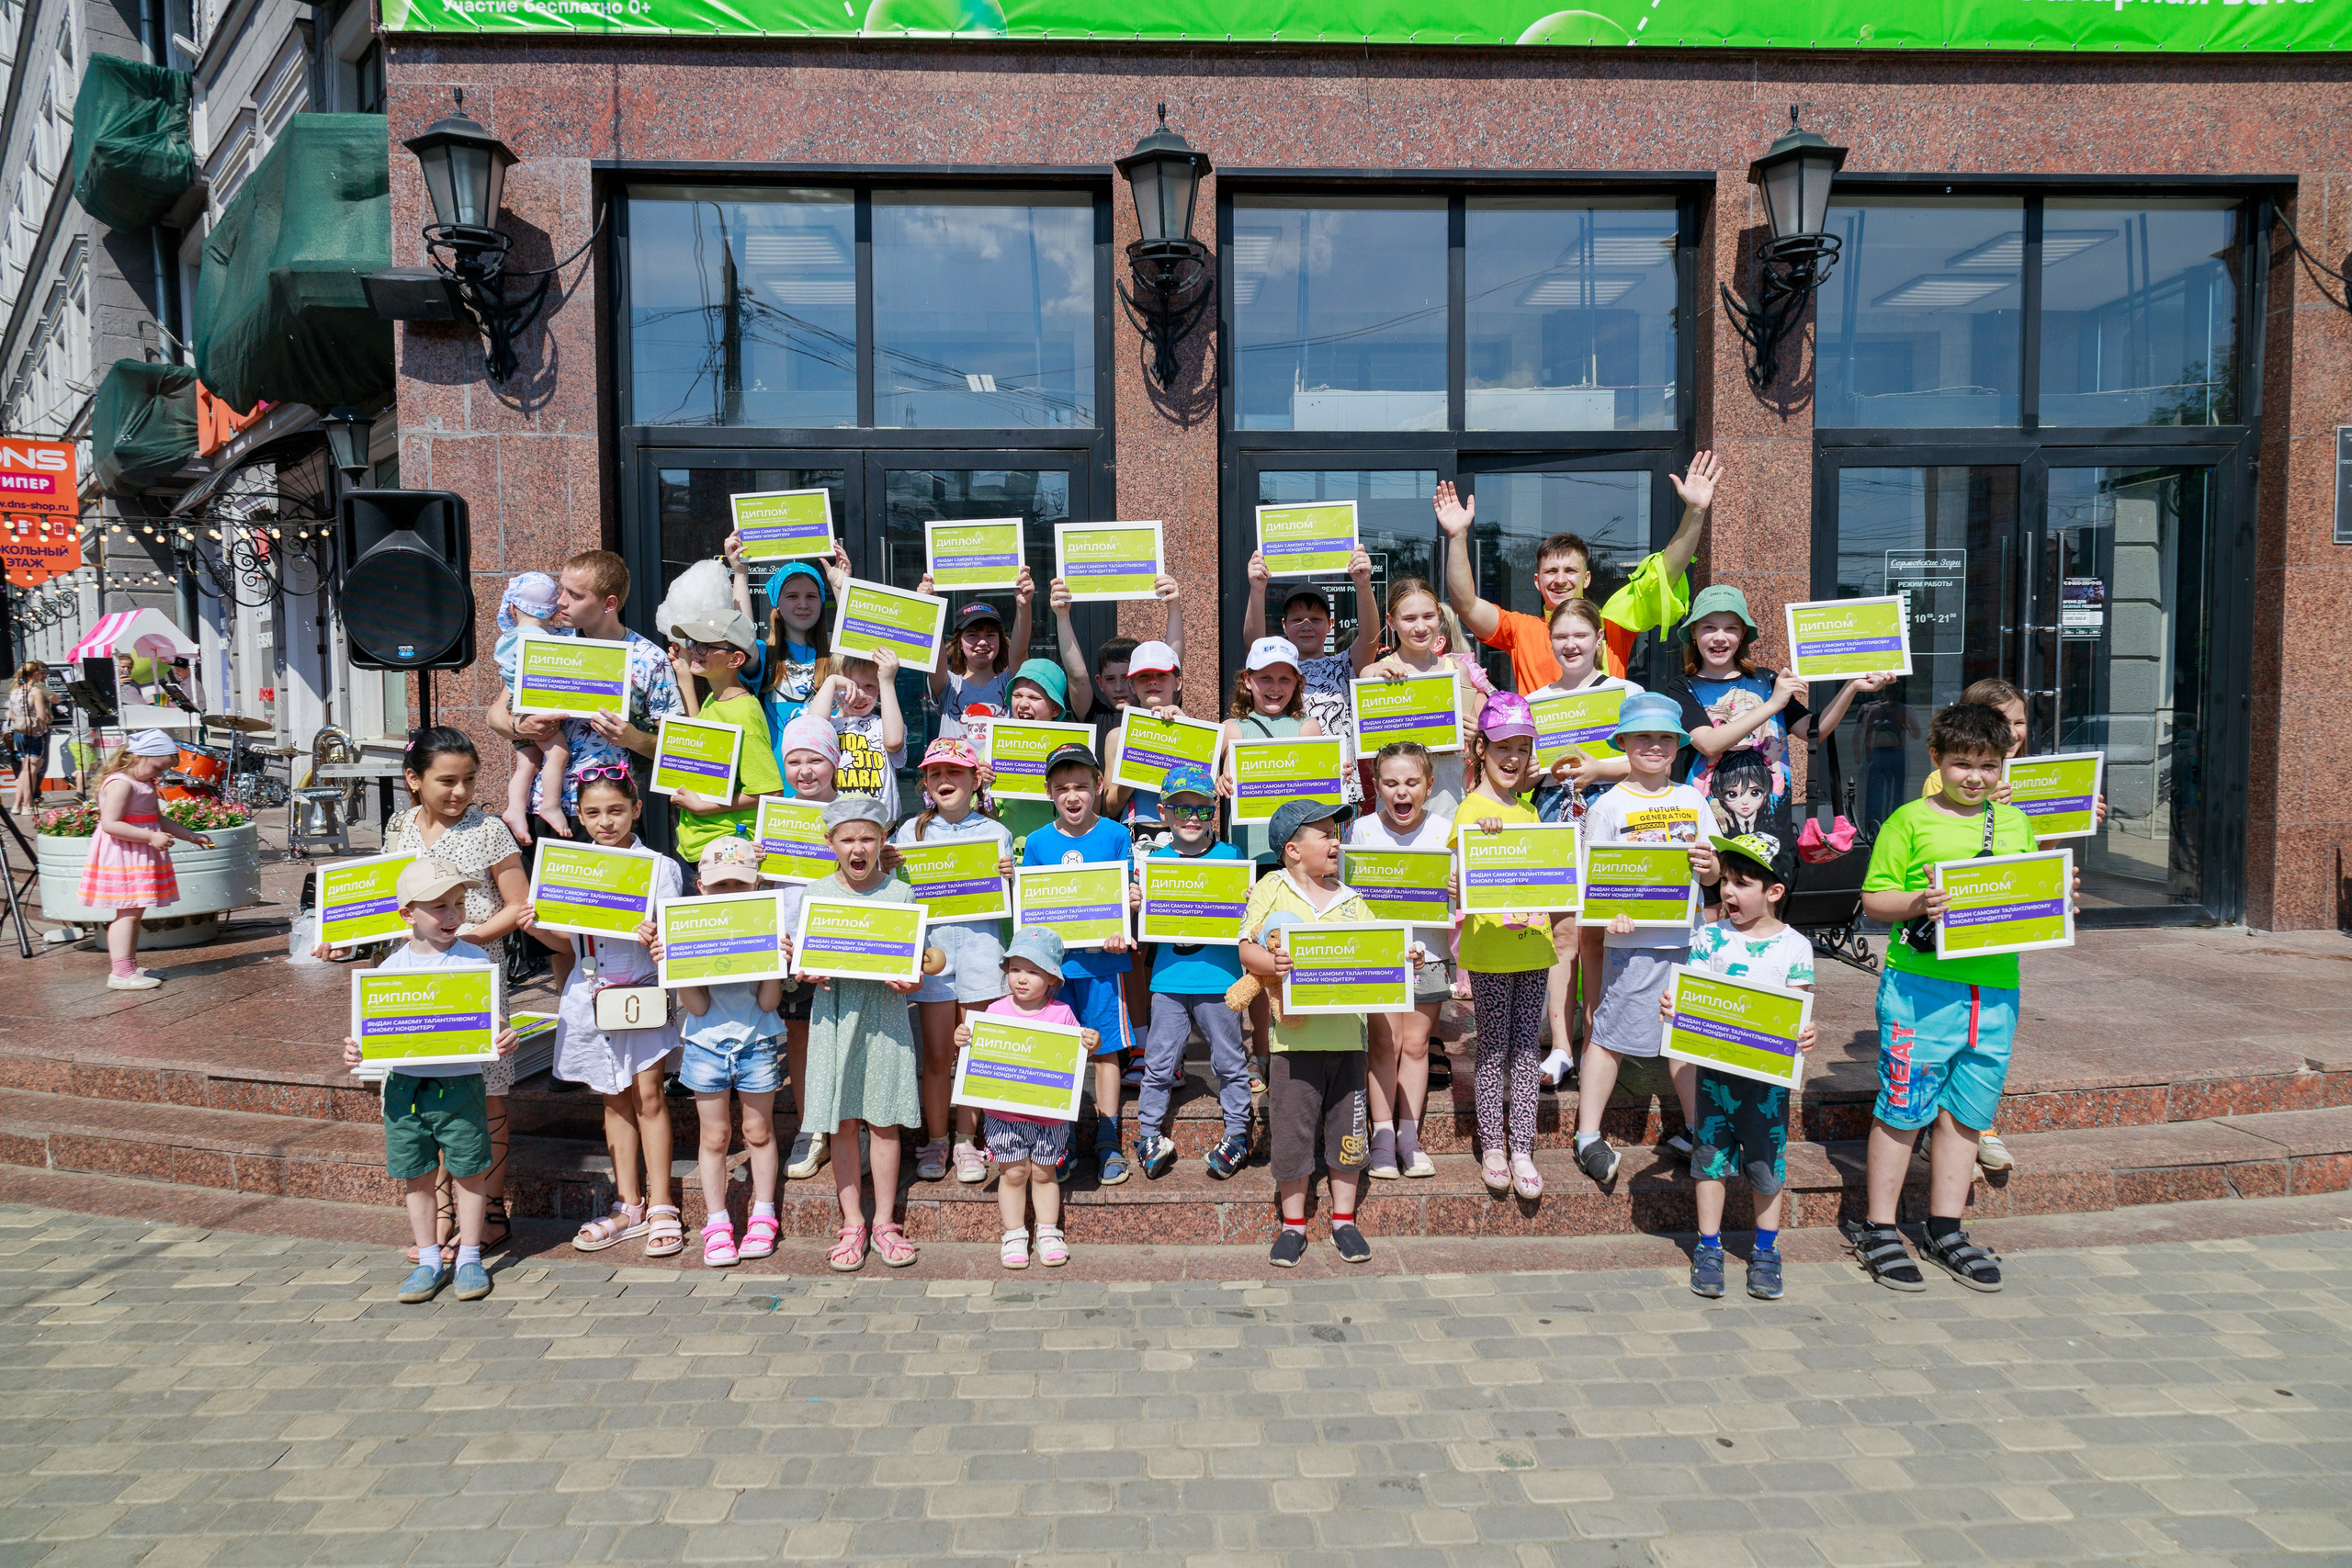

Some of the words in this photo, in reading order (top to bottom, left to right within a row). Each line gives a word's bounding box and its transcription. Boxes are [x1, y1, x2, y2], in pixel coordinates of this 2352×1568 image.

[443, 0, 518, 13] Участие
[525, 0, 622, 14] бесплатно
[628, 0, 651, 15] 0+
[0, 446, 68, 471] NS
[0, 476, 50, 491] ИПЕР
[741, 509, 786, 519] ДИПЛОМ
[1265, 521, 1312, 532] ДИПЛОМ
[936, 538, 980, 547] ДИПЛОМ
[1068, 543, 1115, 553] ДИПЛОМ
[6, 558, 44, 568] ЭТАЖ
[1890, 559, 1939, 570] Сормовские
[1940, 558, 1962, 570] Зори
[850, 599, 898, 616] ДИПЛОМ
[1799, 619, 1852, 632] ДИПЛОМ
[528, 655, 582, 667] ДИПЛОМ
[1362, 695, 1411, 708] ДИПЛОМ
[1536, 708, 1585, 725] ДИПЛОМ
[666, 735, 703, 748] ДИПЛОМ
[837, 733, 869, 751] ПОЛ
[1130, 728, 1176, 744] ДИПЛОМ
[997, 739, 1046, 749] ДИПЛОМ
[851, 749, 885, 770] ЭТО
[1241, 759, 1294, 771] ДИПЛОМ
[836, 768, 883, 789] ЛАВА
[2010, 776, 2057, 790] ДИПЛОМ
[1639, 813, 1691, 822] GENERATION
[768, 818, 820, 831] ДИПЛОМ
[1635, 822, 1665, 830] FEROCIOUS
[1470, 846, 1526, 857] ДИПЛОМ
[430, 862, 456, 880] A
[546, 862, 603, 877] ДИПЛОМ
[900, 860, 954, 874] ДИПЛОМ
[1349, 865, 1403, 874] ДИПЛОМ
[1592, 863, 1647, 873] ДИПЛОМ
[327, 878, 375, 896] ДИПЛОМ
[1150, 878, 1204, 888] ДИПЛОМ
[1948, 880, 2010, 897] ДИПЛОМ
[590, 893, 636, 902] ТАЛАНТЛИВОМУ
[1024, 886, 1077, 897] ДИПЛОМ
[565, 896, 599, 904] КОНДИТЕРУ
[2001, 902, 2051, 913] ТАЛАНТЛИВОМУ
[811, 917, 869, 928] ДИПЛОМ
[1975, 913, 2012, 921] КОНДИТЕРУ
[671, 917, 728, 931] ДИПЛОМ
[1518, 930, 1528, 940] of
[719, 938, 765, 946] ТАЛАНТЛИВОМУ
[1295, 946, 1354, 957] ДИПЛОМ
[368, 991, 434, 1005] ДИПЛОМ
[1681, 991, 1745, 1014] ДИПЛОМ
[1678, 1016, 1701, 1025] ВЫДАН
[1702, 1021, 1729, 1032] САМОМУ
[1730, 1028, 1783, 1045] ТАЛАНТЛИВОМУ
[1678, 1021, 1702, 1031] ЮНОМУ
[1703, 1028, 1740, 1041] КОНДИТЕРУ
[975, 1037, 1031, 1054] ДИПЛОМ
[1888, 1021, 1915, 1108] HEAT
[993, 1071, 1027, 1079] КОНДИТЕРУ
[1018, 1068, 1063, 1079] ТАЛАНТЛИВОМУ
